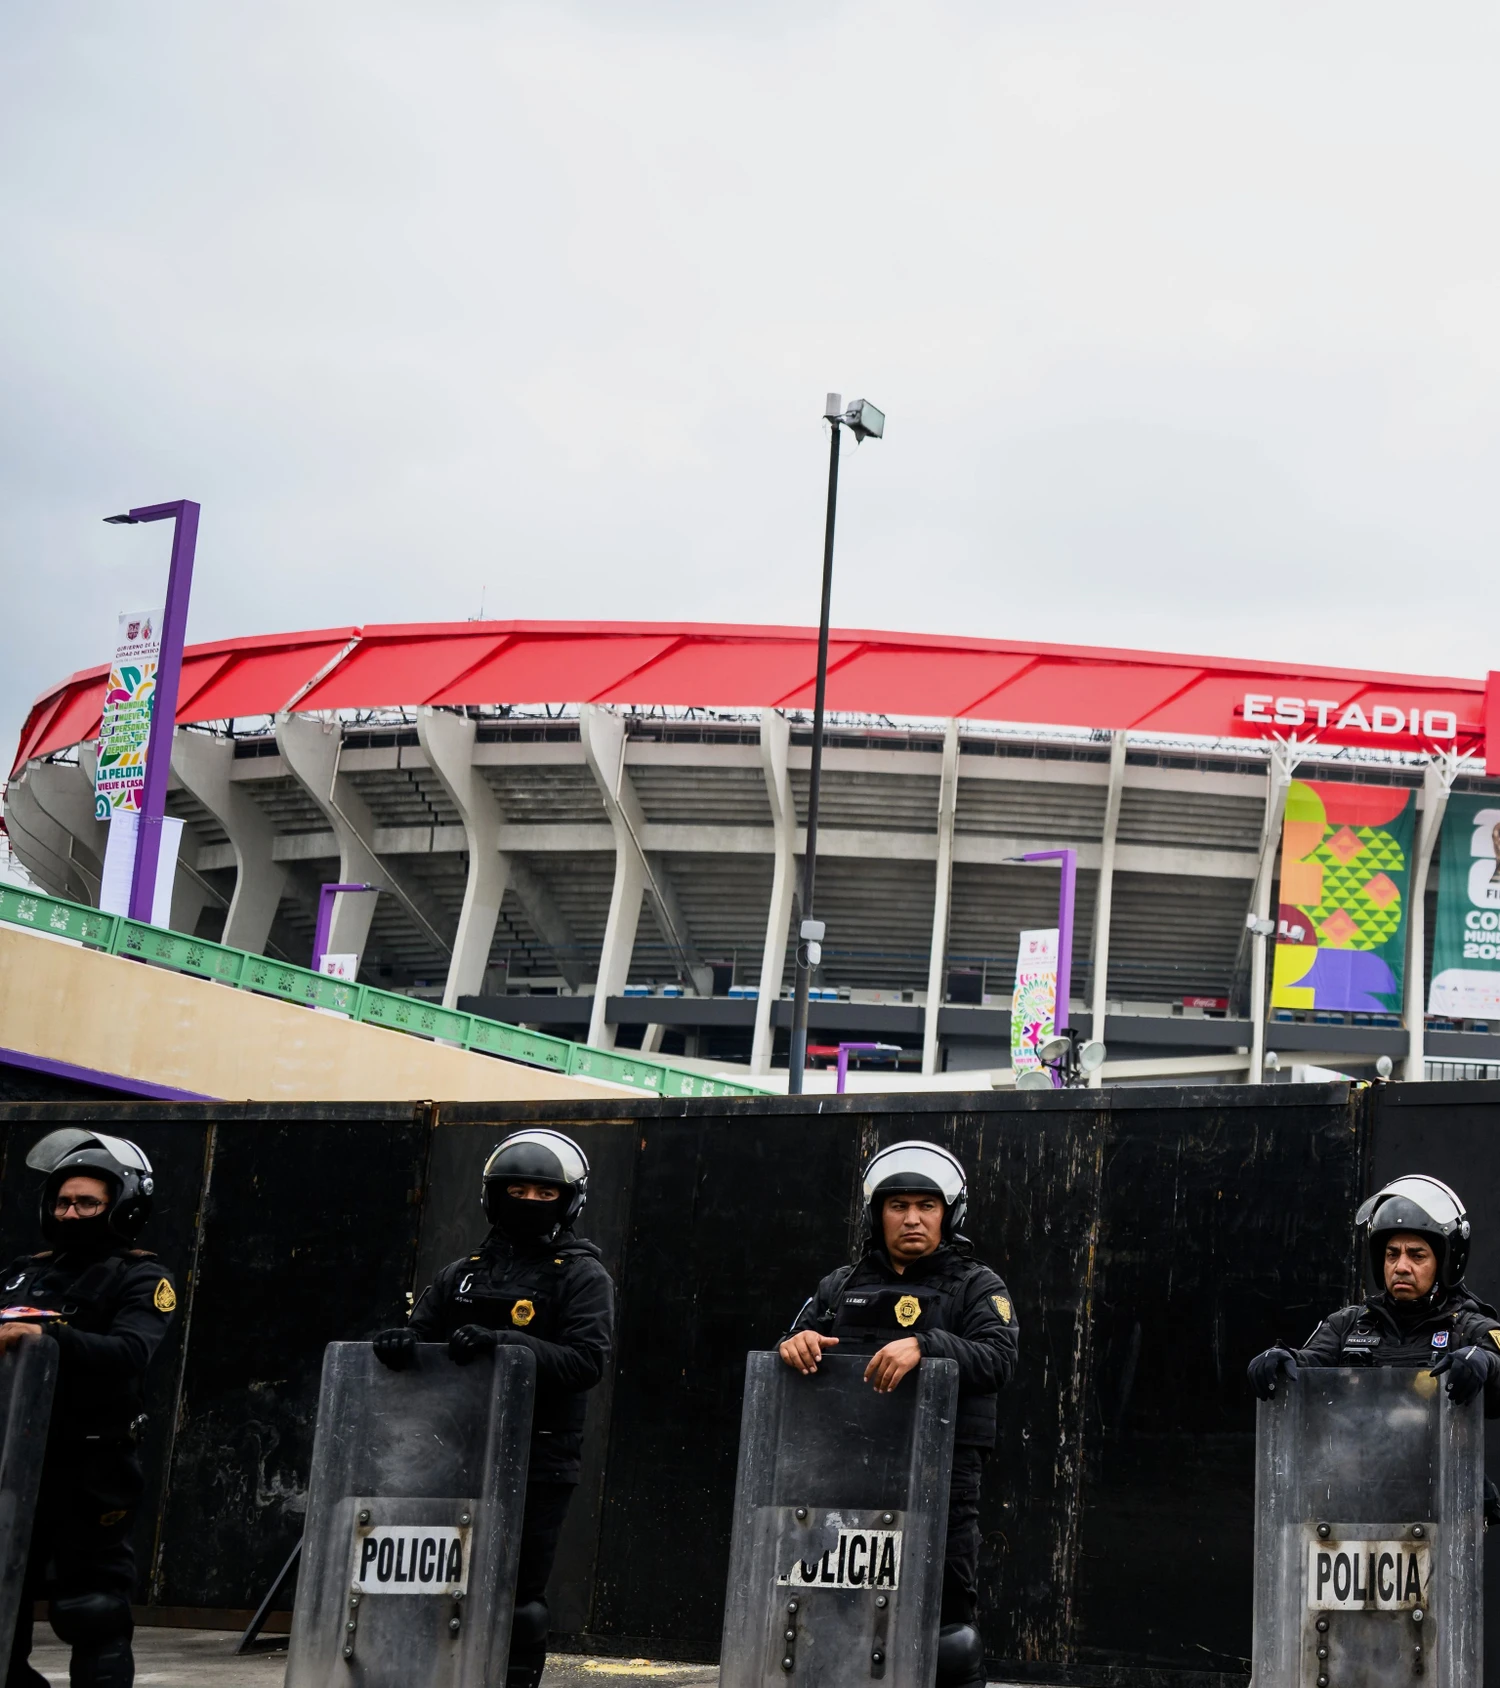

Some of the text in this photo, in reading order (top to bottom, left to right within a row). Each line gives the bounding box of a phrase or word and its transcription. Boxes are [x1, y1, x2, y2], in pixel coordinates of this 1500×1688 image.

[117, 643, 143, 652] GOBIERNO
[118, 700, 148, 710] MUNDIAL
[118, 712, 140, 721] MUEVE
[1242, 693, 1457, 739] ESTADIO
[114, 722, 149, 733] PERSONAS
[106, 744, 136, 755] DEPORTE
[97, 766, 143, 781] LA PELOTA
[121, 781, 125, 789] A
[126, 779, 144, 788] CASA
[359, 1537, 462, 1583] POLICIA
[1317, 1552, 1421, 1602] POLICIA
